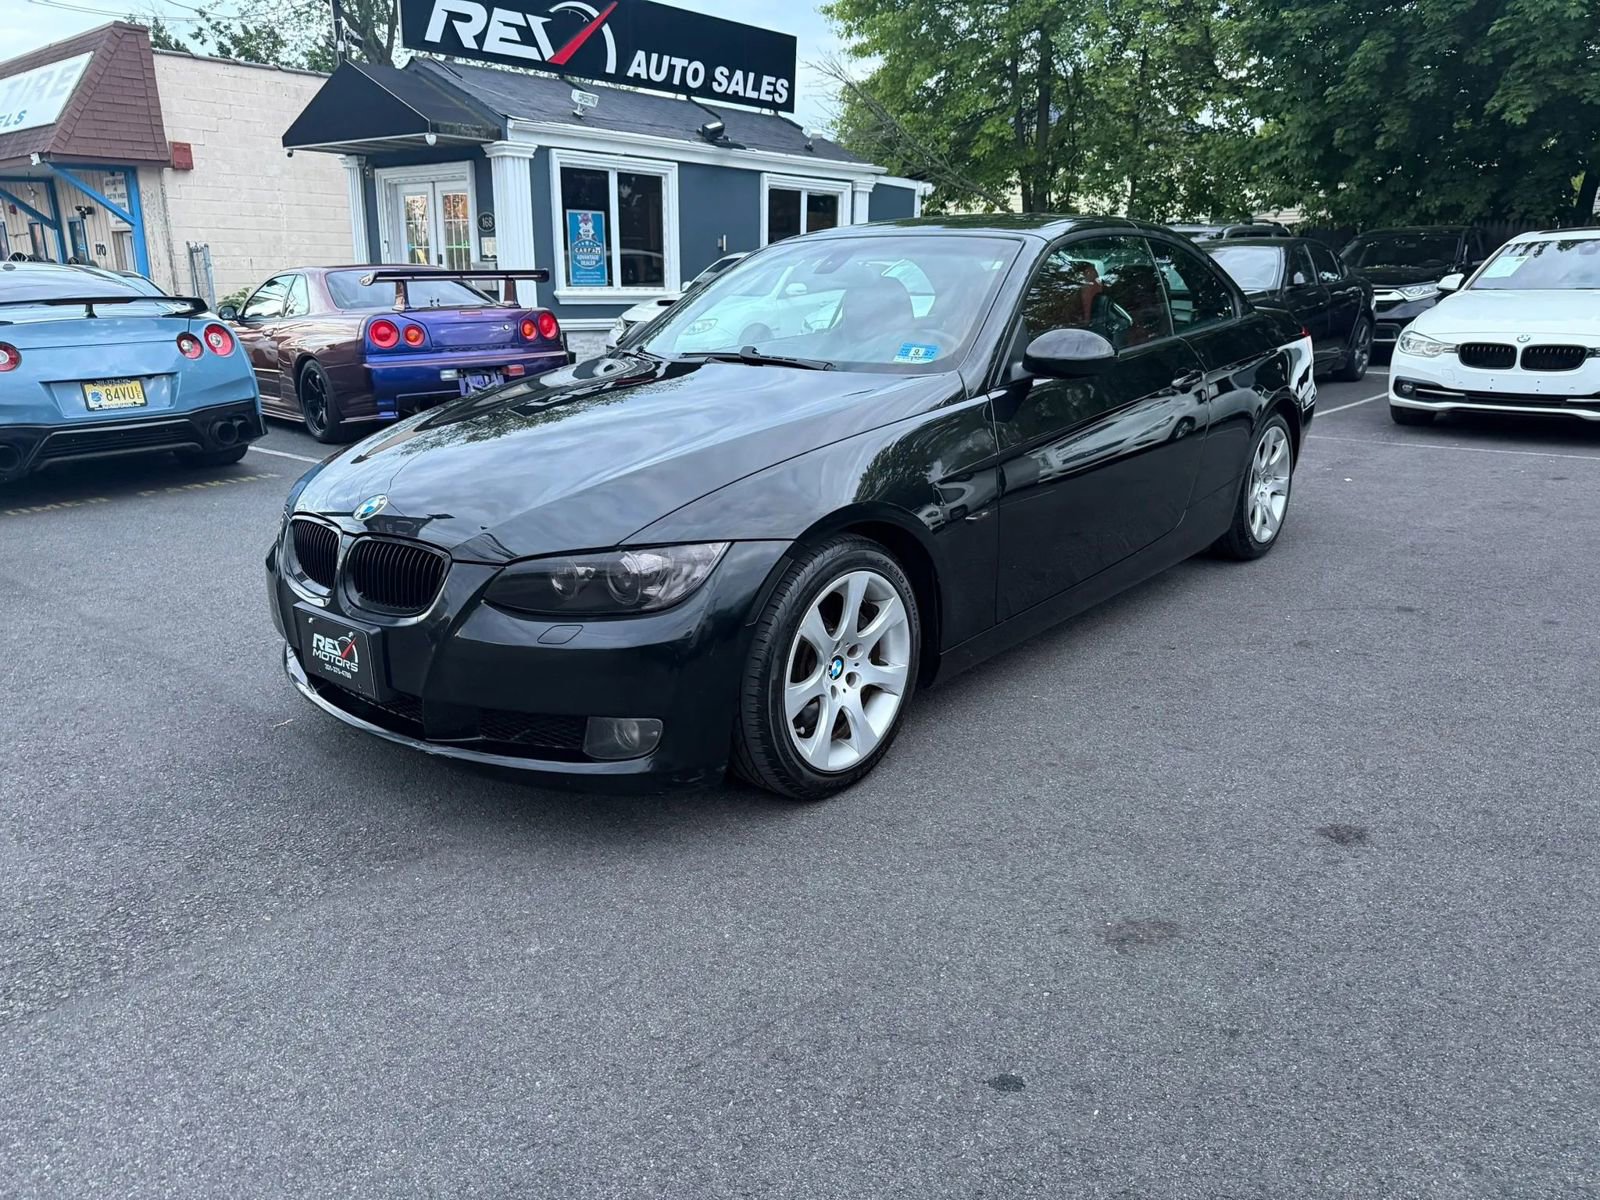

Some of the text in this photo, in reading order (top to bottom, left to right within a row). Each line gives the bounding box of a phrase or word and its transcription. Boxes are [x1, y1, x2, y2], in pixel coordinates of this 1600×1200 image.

[626, 49, 789, 104] AUTO SALES
[482, 215, 493, 228] 168
[312, 648, 359, 673] MOTORS
